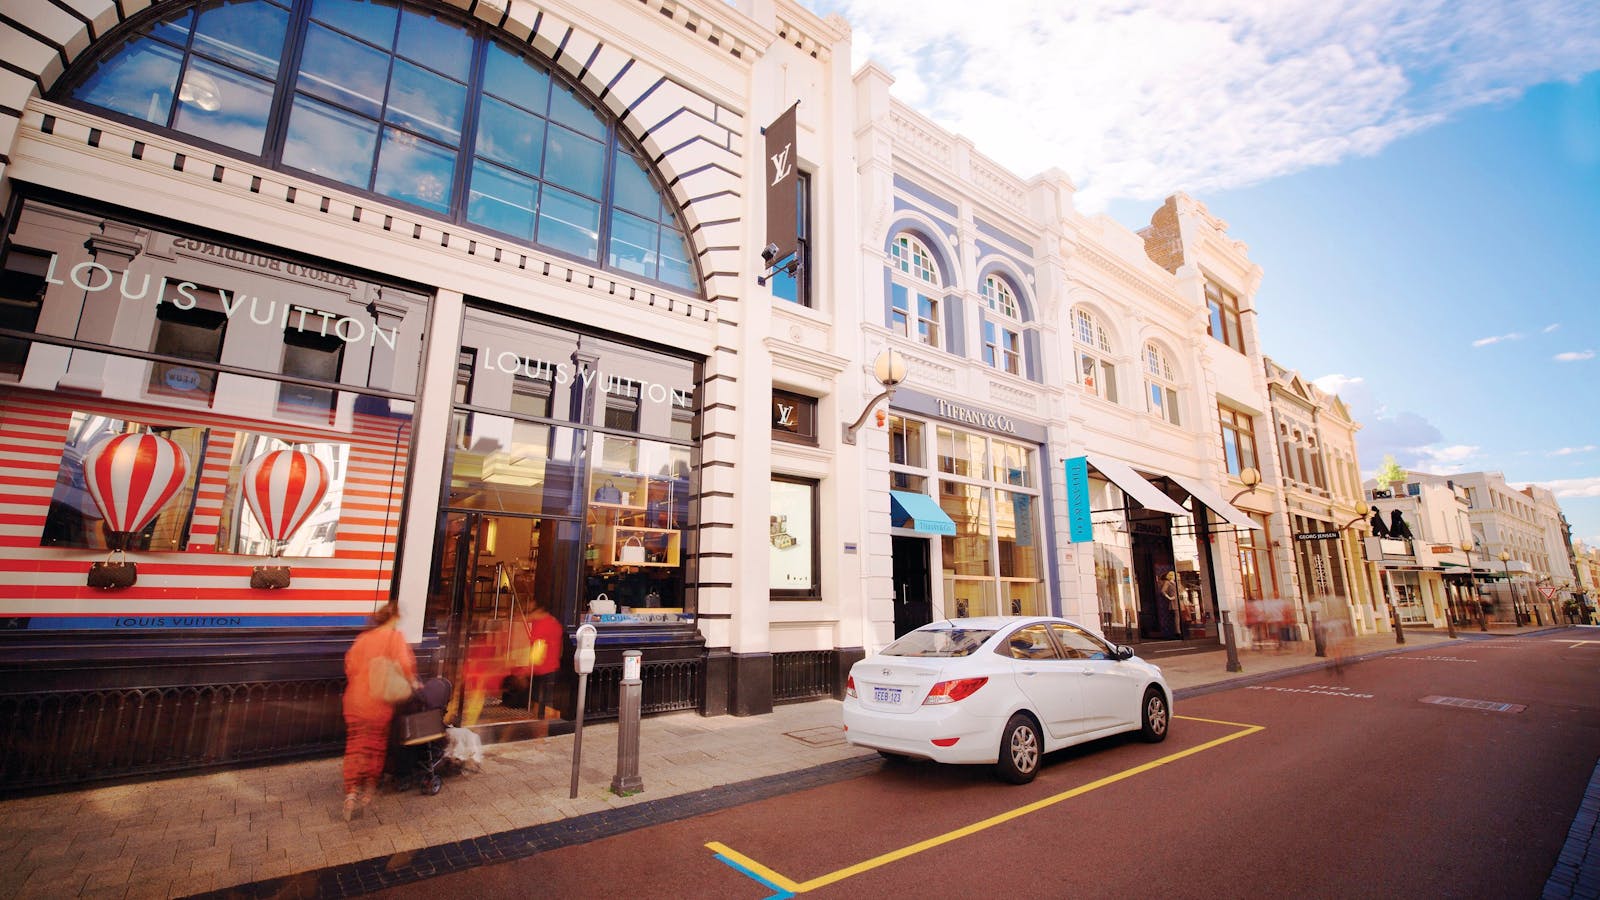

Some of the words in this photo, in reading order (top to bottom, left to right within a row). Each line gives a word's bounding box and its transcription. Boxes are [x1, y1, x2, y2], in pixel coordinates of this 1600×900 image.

[45, 254, 198, 310] LOUIS
[219, 289, 397, 351] VUITTON
[484, 347, 568, 384] LOUIS
[580, 367, 686, 409] VUITTON
[115, 617, 166, 627] LOUIS
[172, 616, 240, 626] VUITTON
